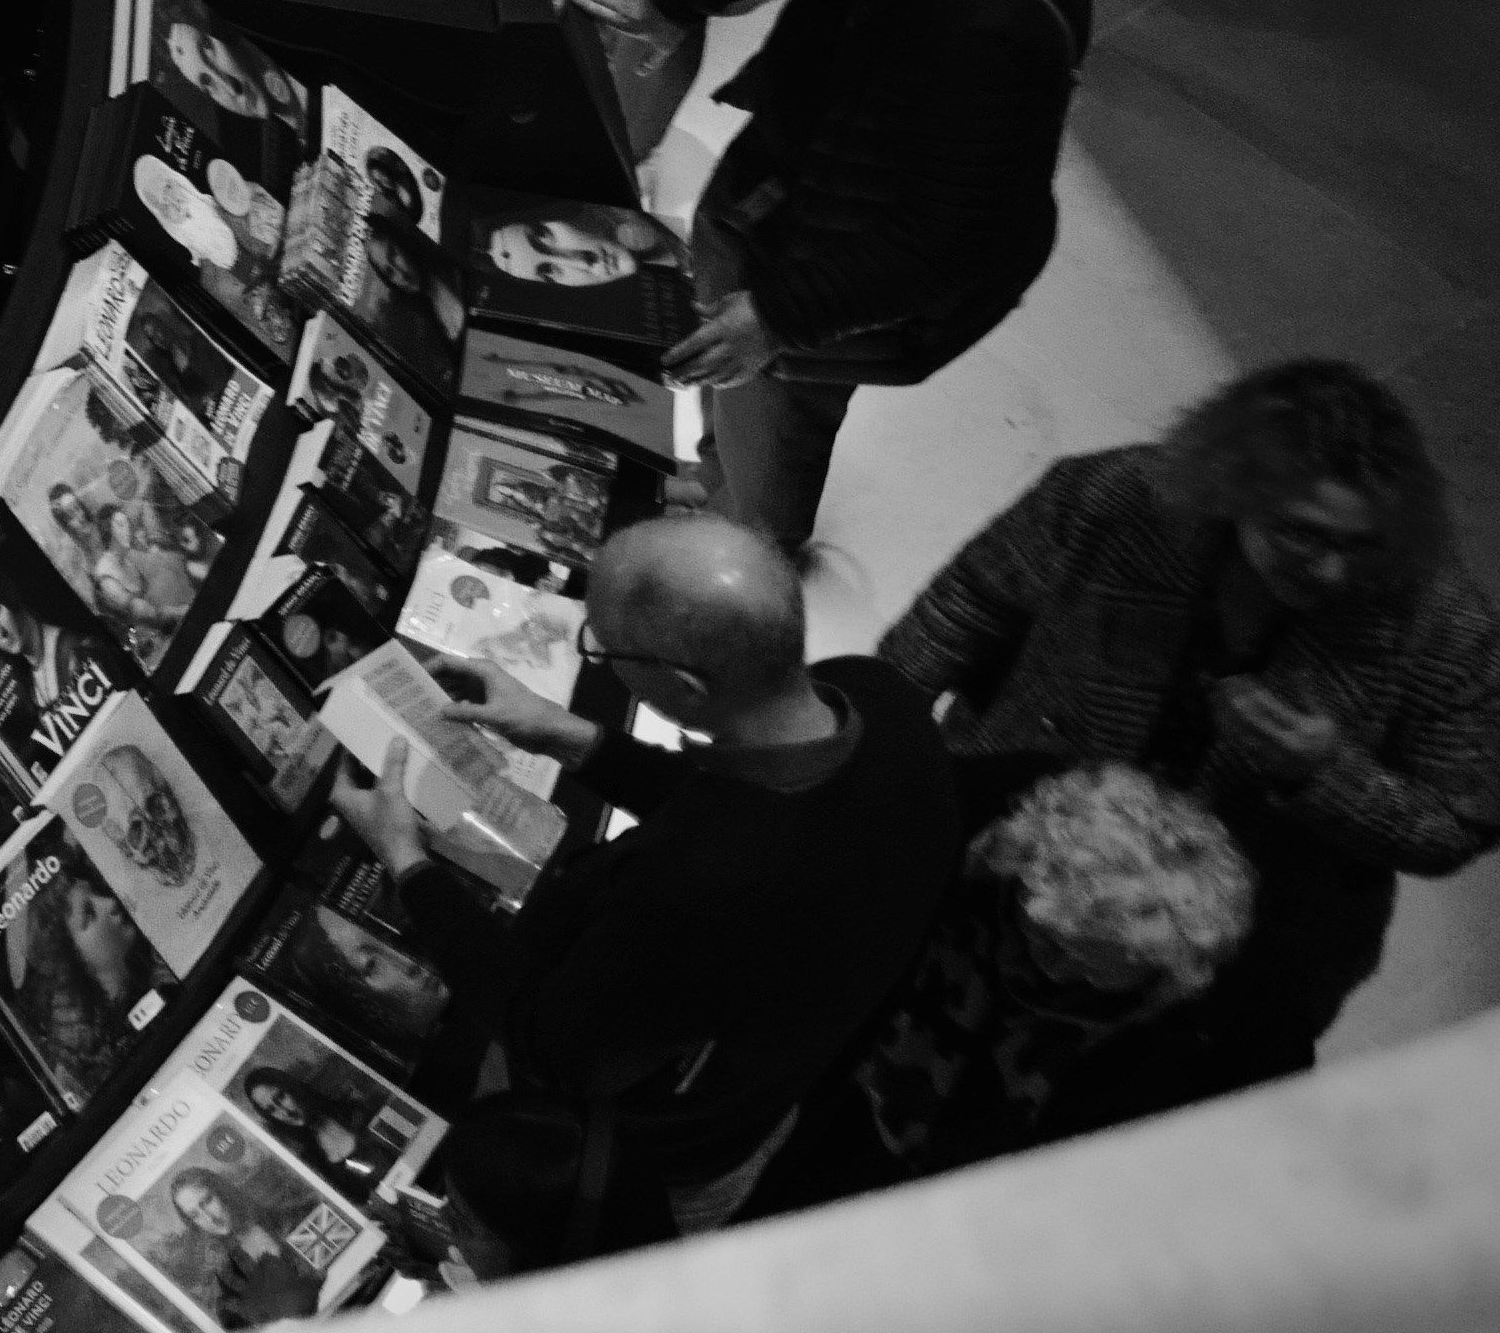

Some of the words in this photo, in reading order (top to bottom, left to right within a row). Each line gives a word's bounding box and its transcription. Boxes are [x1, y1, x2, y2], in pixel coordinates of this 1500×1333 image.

[29, 657, 111, 755] VINCI
[94, 1096, 193, 1198] LEONARDO
[21, 1292, 54, 1327] VINCI
